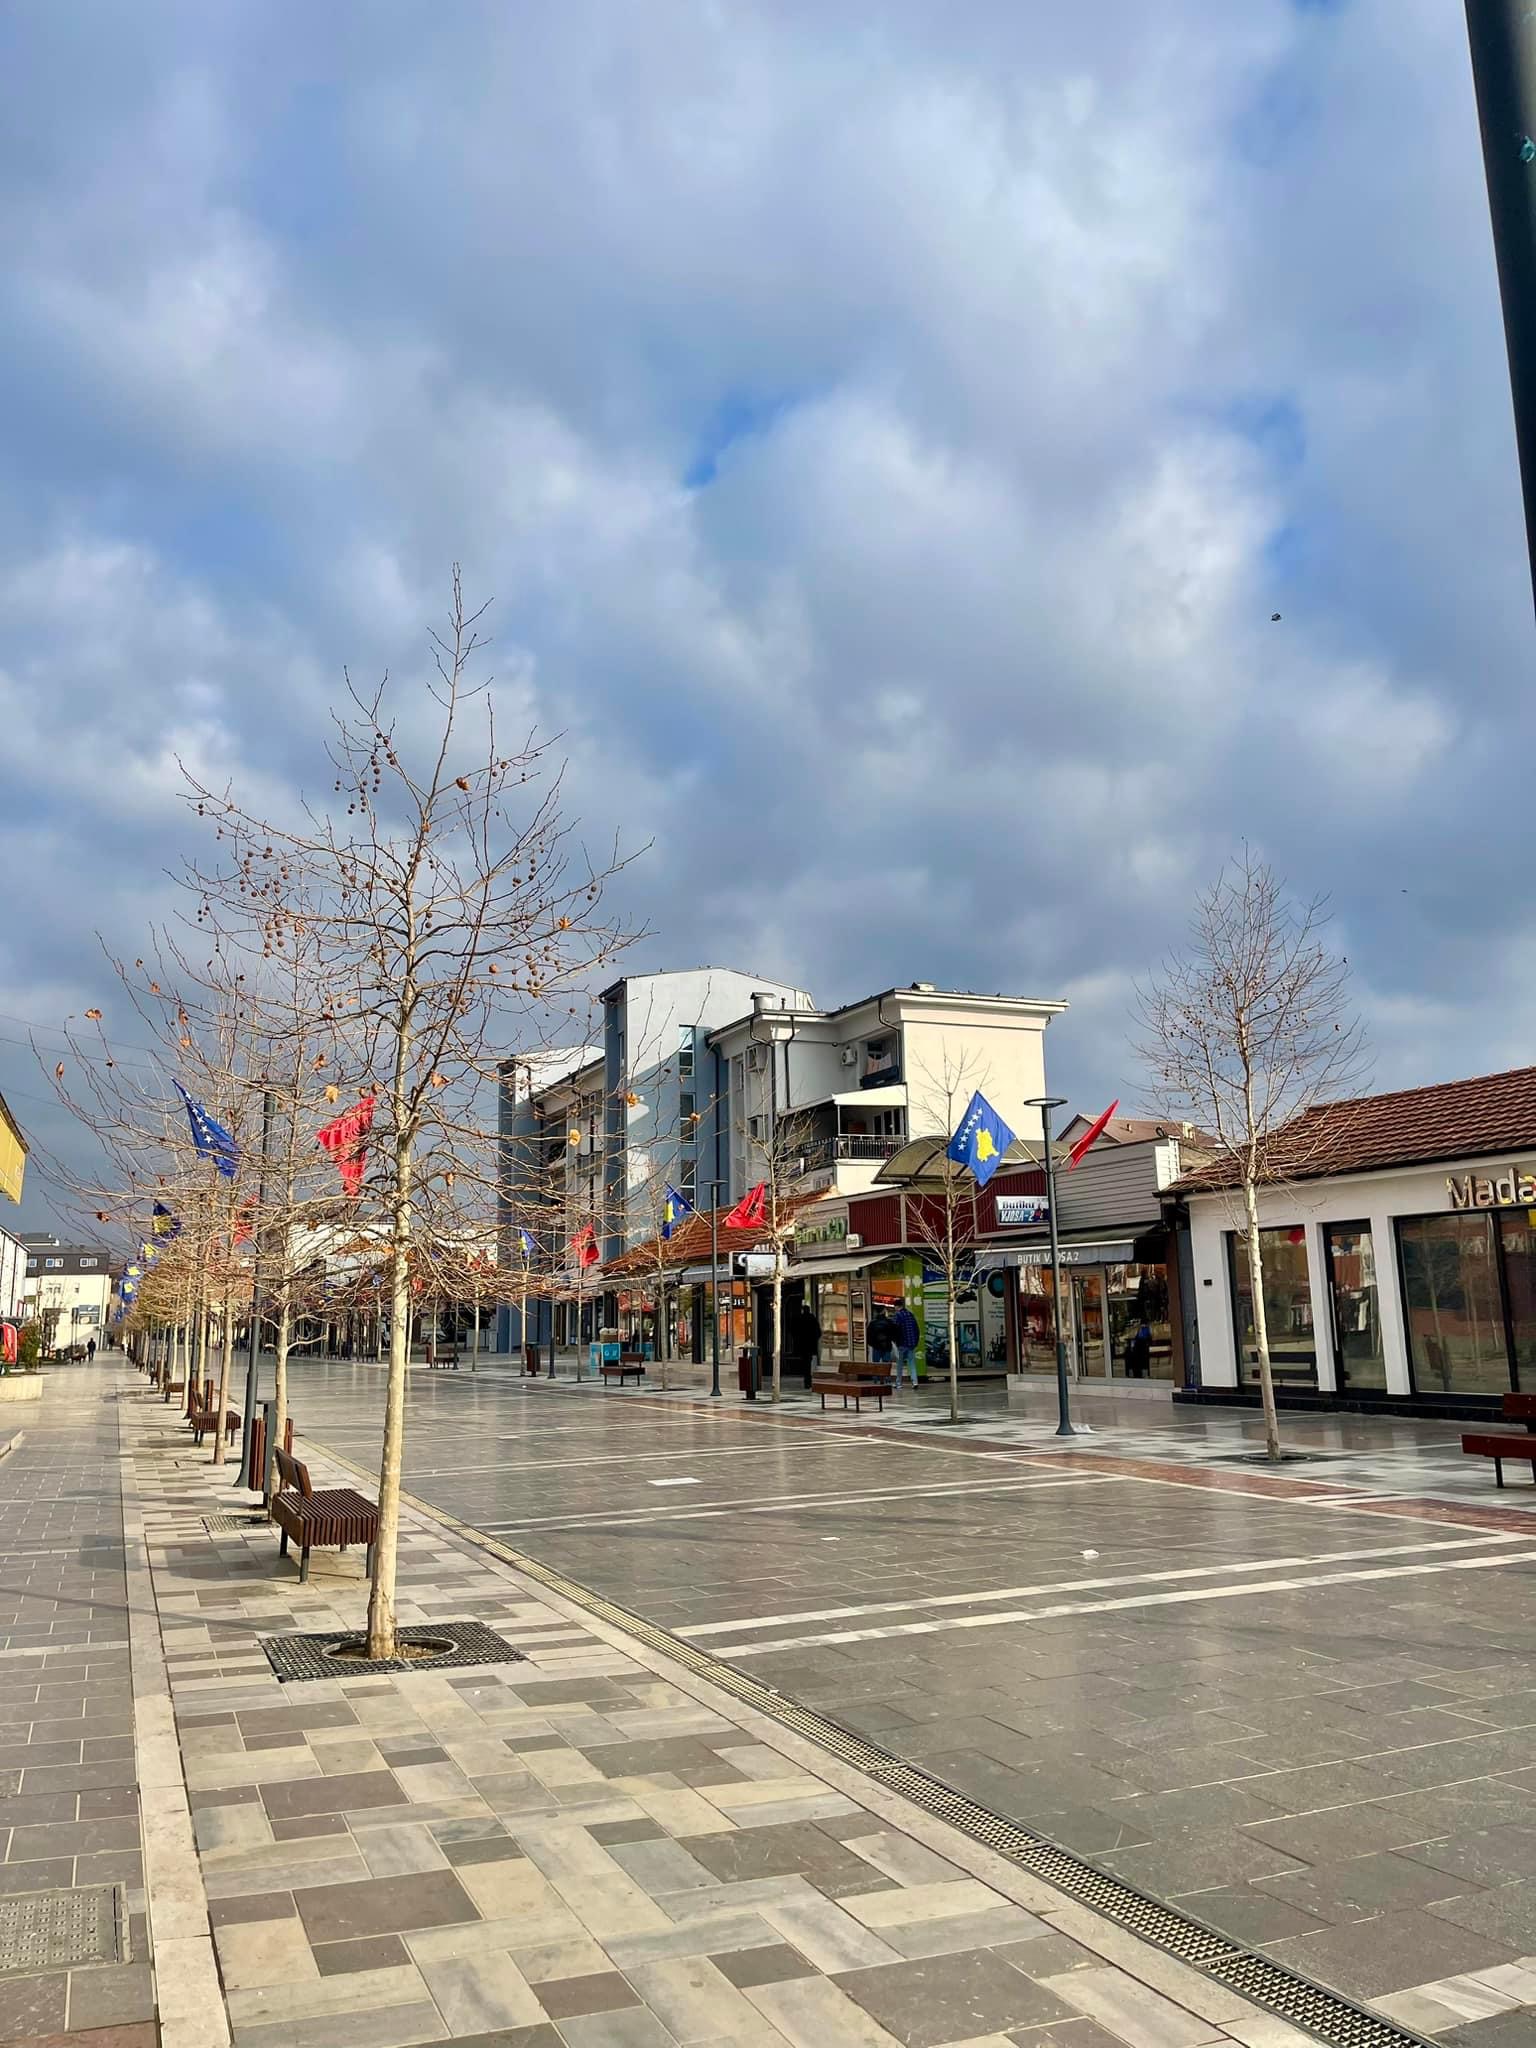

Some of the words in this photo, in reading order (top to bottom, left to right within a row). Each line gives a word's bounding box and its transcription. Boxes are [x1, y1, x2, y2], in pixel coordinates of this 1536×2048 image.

[1446, 1167, 1536, 1208] Mada
[1001, 1210, 1035, 1222] VJOSA-2
[1017, 1253, 1041, 1264] BUTIK
